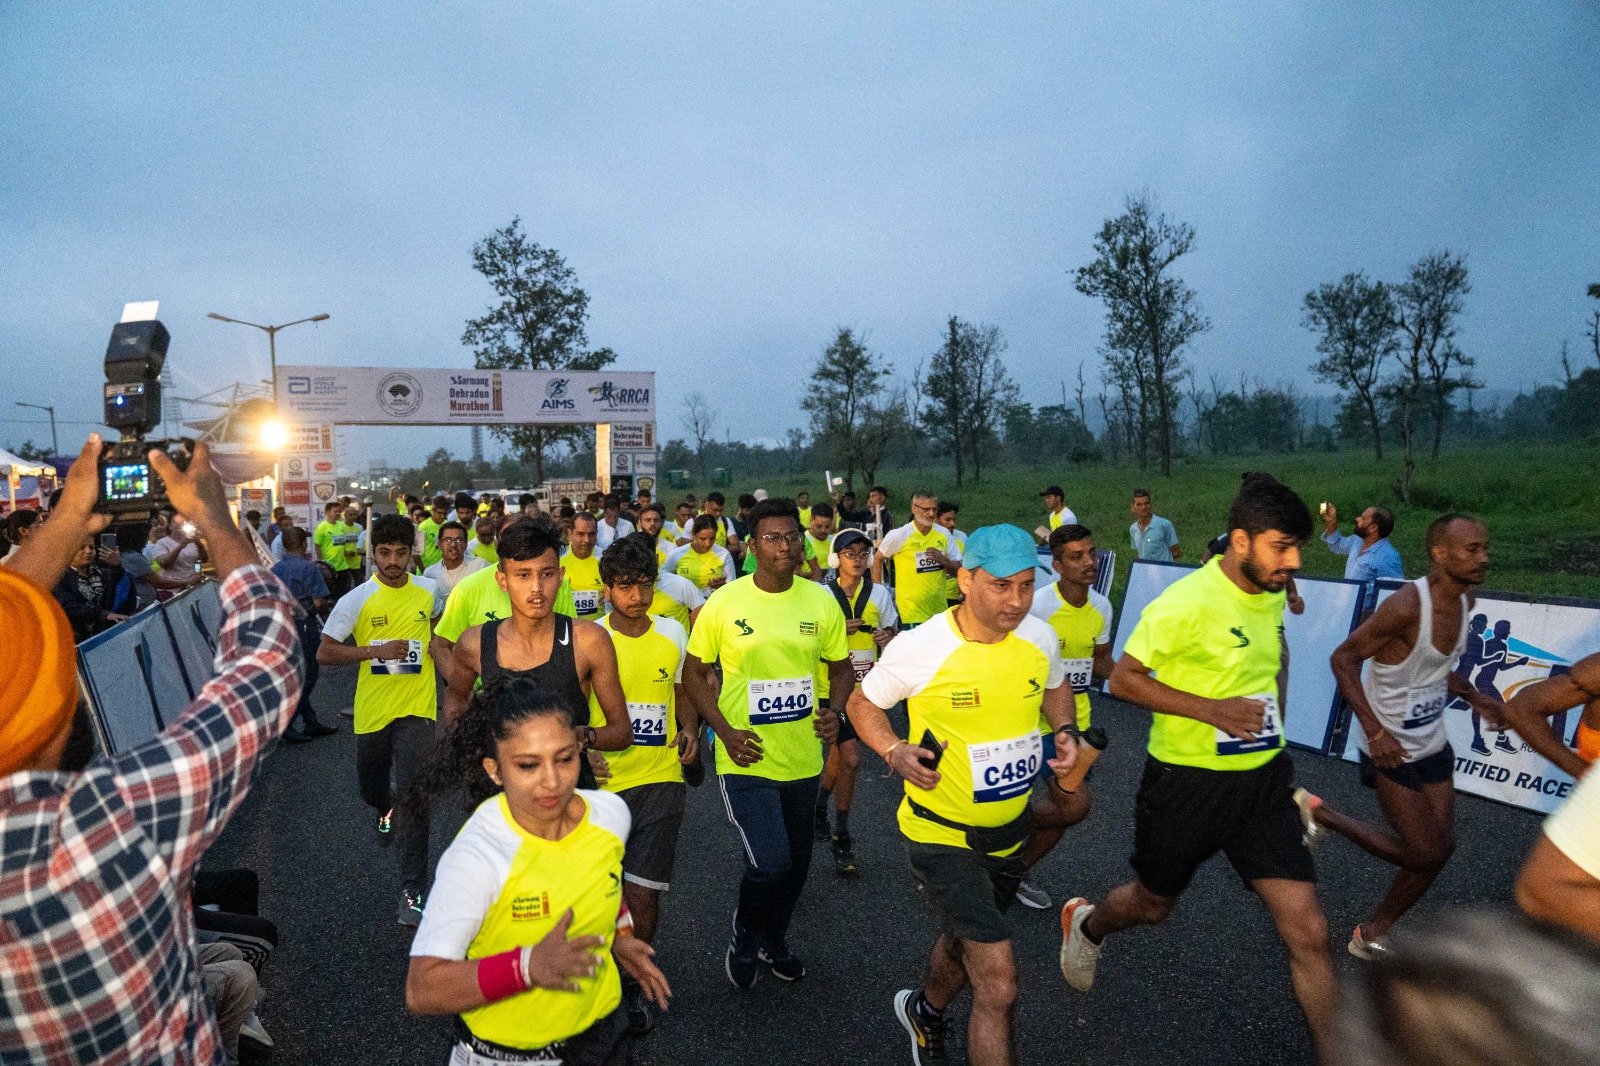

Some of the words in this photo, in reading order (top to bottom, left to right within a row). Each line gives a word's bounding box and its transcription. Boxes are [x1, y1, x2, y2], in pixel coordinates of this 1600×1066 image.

[457, 375, 490, 387] Sarmang
[449, 388, 490, 398] Dehradun
[619, 388, 649, 404] RRCA
[450, 400, 490, 411] Marathon
[541, 399, 576, 409] AIMS
[757, 693, 808, 712] C440
[632, 718, 664, 734] 424
[984, 754, 1037, 787] C480
[1513, 771, 1573, 798] RACE
